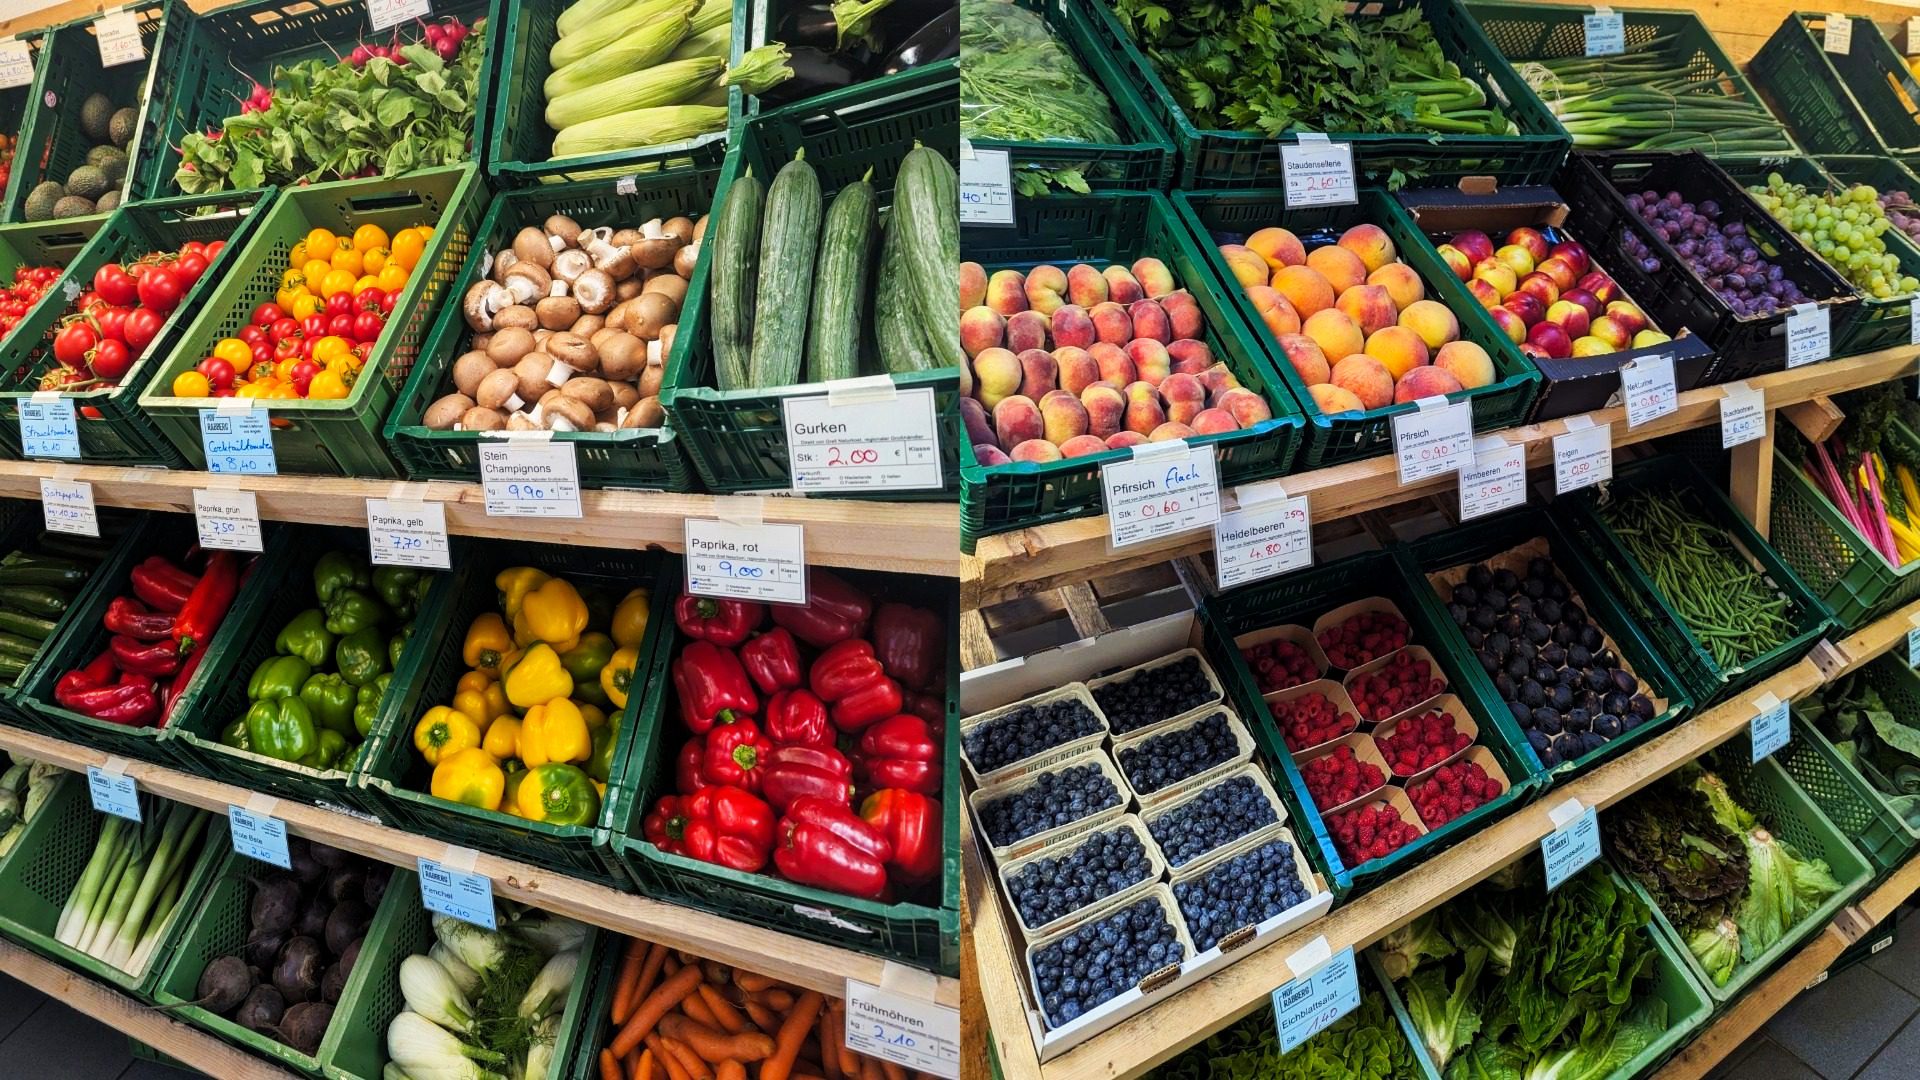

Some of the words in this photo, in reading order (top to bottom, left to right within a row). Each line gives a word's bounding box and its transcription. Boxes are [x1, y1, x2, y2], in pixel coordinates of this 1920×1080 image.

[1287, 160, 1342, 170] Staudensellerie
[795, 422, 847, 435] Gurken
[1400, 429, 1430, 442] Pfirsich
[484, 452, 508, 461] Stein
[797, 453, 813, 463] Stk
[1558, 449, 1579, 459] Feigen
[485, 464, 552, 475] Champignons
[1464, 468, 1501, 482] Himbeeren
[1113, 480, 1155, 496] Pfirsich
[1119, 511, 1131, 519] Stk
[407, 518, 424, 528] gelb
[1221, 522, 1285, 543] Heidelbeeren
[692, 538, 739, 552] Paprika,
[743, 543, 759, 553] rot
[697, 564, 706, 572] kg
[424, 885, 453, 900] Fenchel
[851, 998, 924, 1028] Frühmöhren
[1282, 990, 1338, 1030] Eichblattsalat
